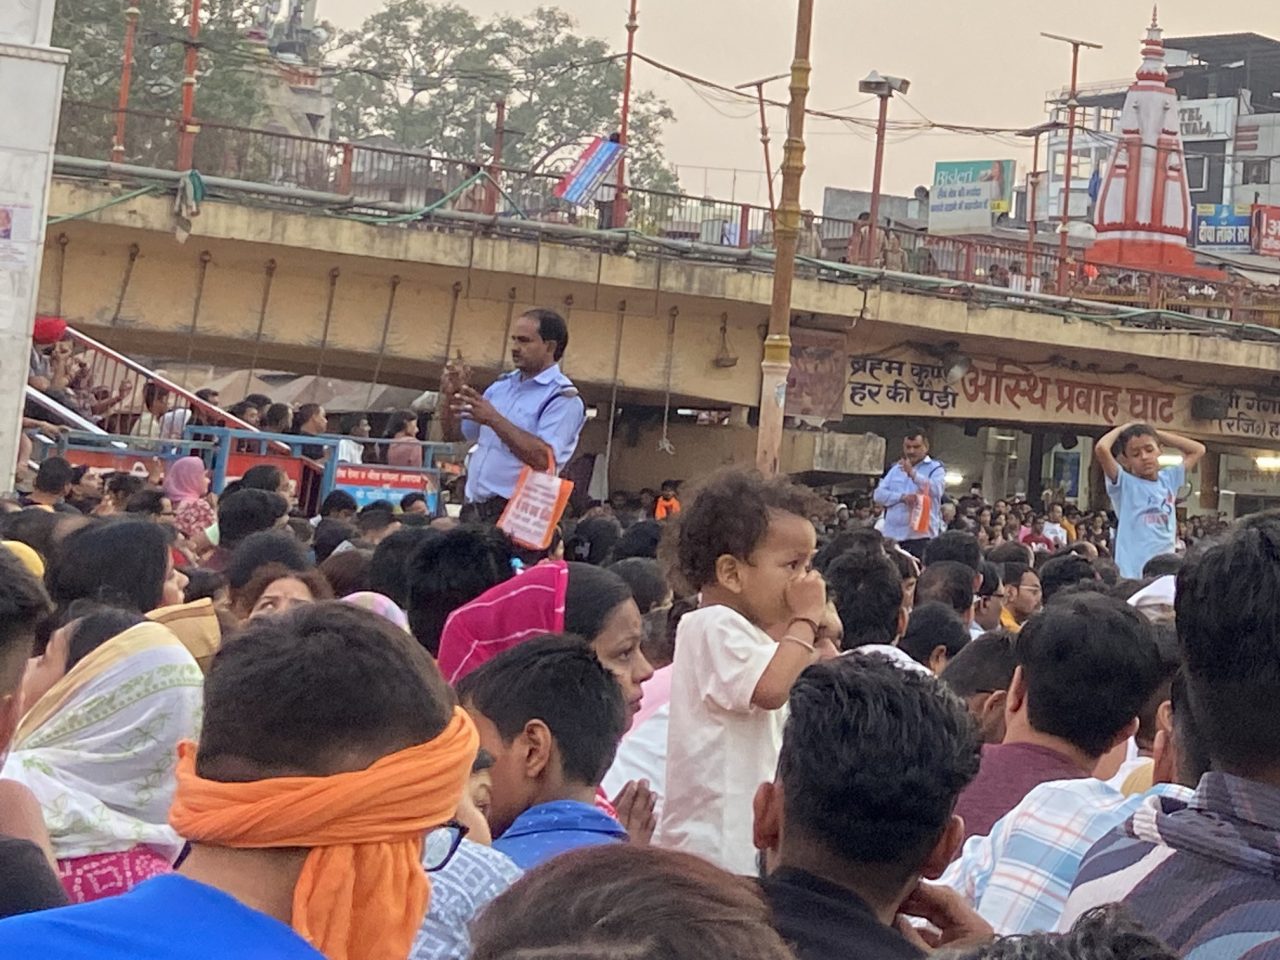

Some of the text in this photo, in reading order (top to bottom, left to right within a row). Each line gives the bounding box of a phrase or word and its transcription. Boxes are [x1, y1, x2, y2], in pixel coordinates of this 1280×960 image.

[849, 382, 883, 406] हर
[886, 381, 911, 404] की
[1053, 374, 1123, 423] प्रवाह
[1126, 388, 1177, 423] घाट
